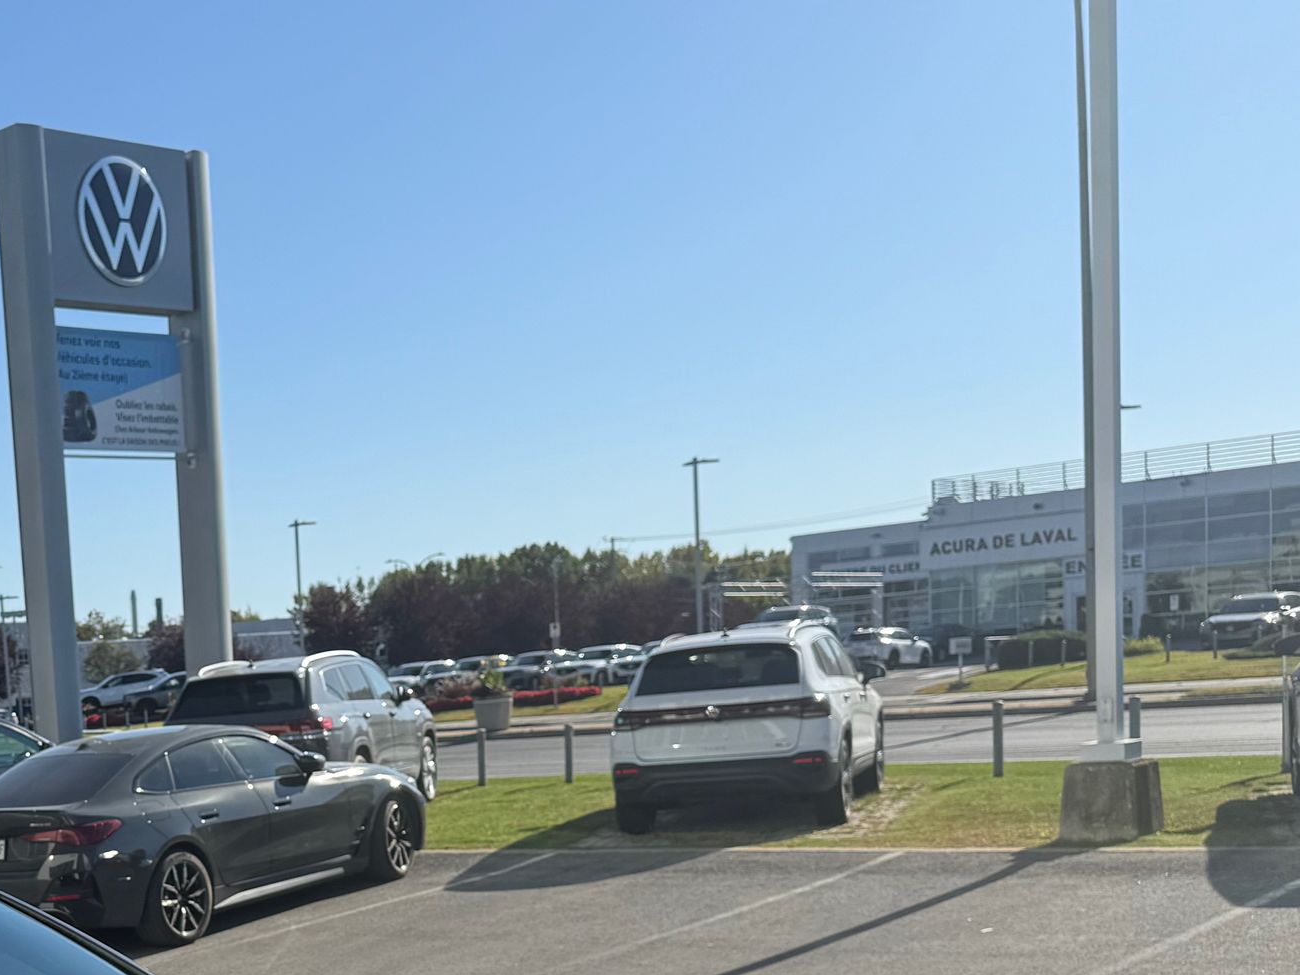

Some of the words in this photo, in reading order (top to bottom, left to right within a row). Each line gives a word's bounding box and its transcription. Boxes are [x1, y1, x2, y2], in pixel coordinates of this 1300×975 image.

[103, 339, 121, 349] nos
[929, 537, 988, 556] ACURA
[992, 533, 1016, 550] DE
[1020, 527, 1078, 547] LAVAL
